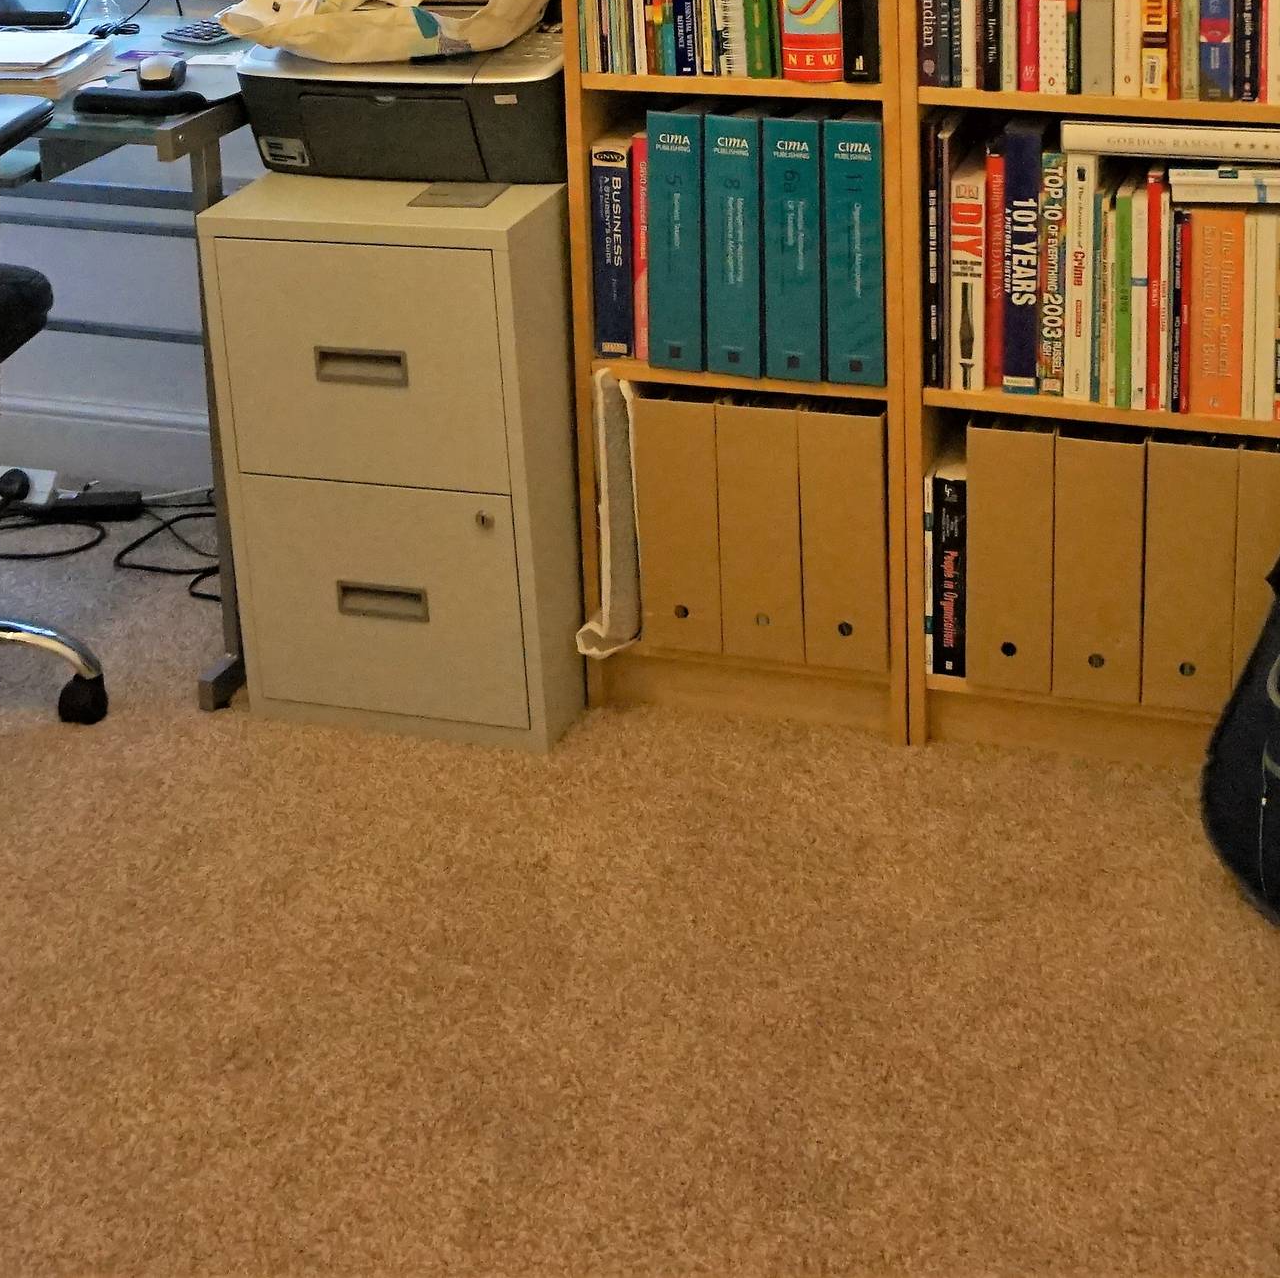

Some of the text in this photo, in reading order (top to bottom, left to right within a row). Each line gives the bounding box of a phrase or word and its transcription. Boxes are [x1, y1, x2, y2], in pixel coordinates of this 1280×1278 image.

[613, 177, 623, 267] BUSINESS
[951, 202, 982, 258] DIY
[1011, 199, 1037, 306] 101 YEARS
[1042, 167, 1063, 339] TOP 10 OF EVERYTHING 2003
[1222, 230, 1233, 254] The
[1073, 251, 1085, 287] Crime
[1042, 340, 1051, 357] ASH
[1051, 341, 1062, 374] RUSSELL
[941, 551, 959, 578] People
[944, 580, 958, 589] in
[940, 592, 958, 648] Organisations
